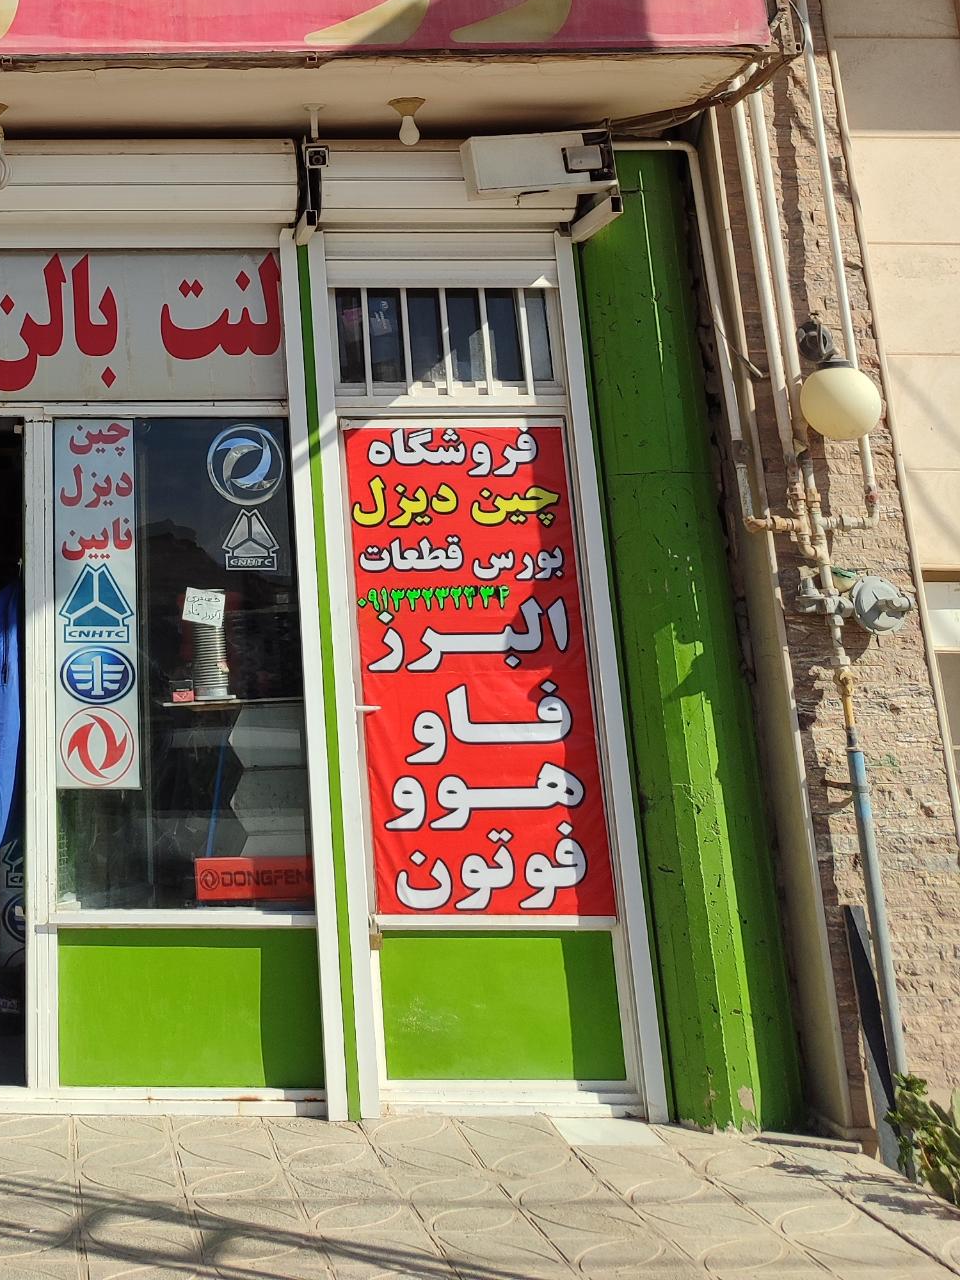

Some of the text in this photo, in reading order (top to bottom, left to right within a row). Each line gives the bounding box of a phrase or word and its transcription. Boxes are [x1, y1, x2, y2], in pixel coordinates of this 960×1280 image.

[160, 252, 282, 361] لنت
[69, 422, 131, 456] چین
[367, 426, 538, 477] فروشگاه
[59, 463, 133, 508] دیزل
[352, 475, 561, 527] چین دیزل
[61, 517, 133, 561] نایین
[358, 534, 565, 580] بورس قطعات
[67, 630, 126, 638] CNHTC
[367, 596, 570, 673] البرز
[404, 679, 573, 766] فاو
[384, 761, 586, 831] هوو
[394, 820, 589, 911] فوتون
